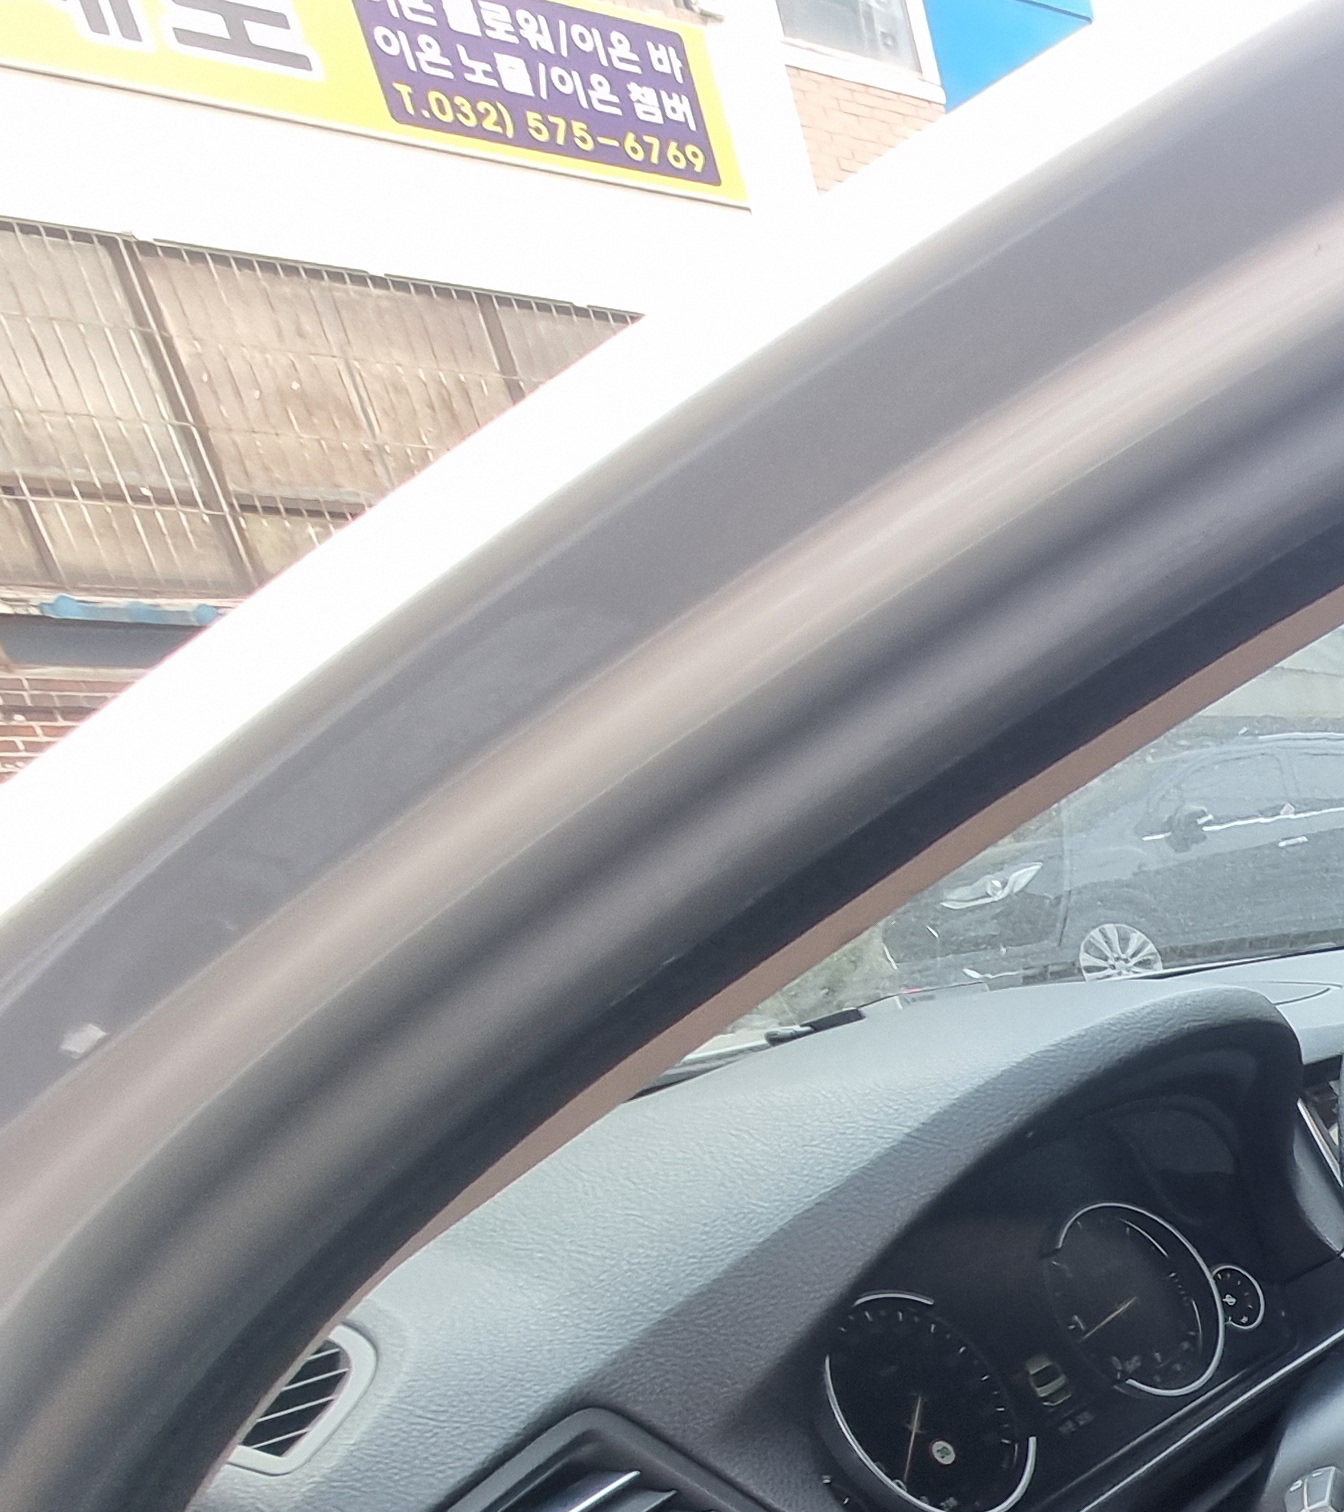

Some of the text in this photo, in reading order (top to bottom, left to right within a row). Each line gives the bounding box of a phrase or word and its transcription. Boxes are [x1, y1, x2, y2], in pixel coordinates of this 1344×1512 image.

[373, 26, 454, 79] 이온
[646, 40, 684, 83] 바
[526, 110, 705, 173] 575-6769
